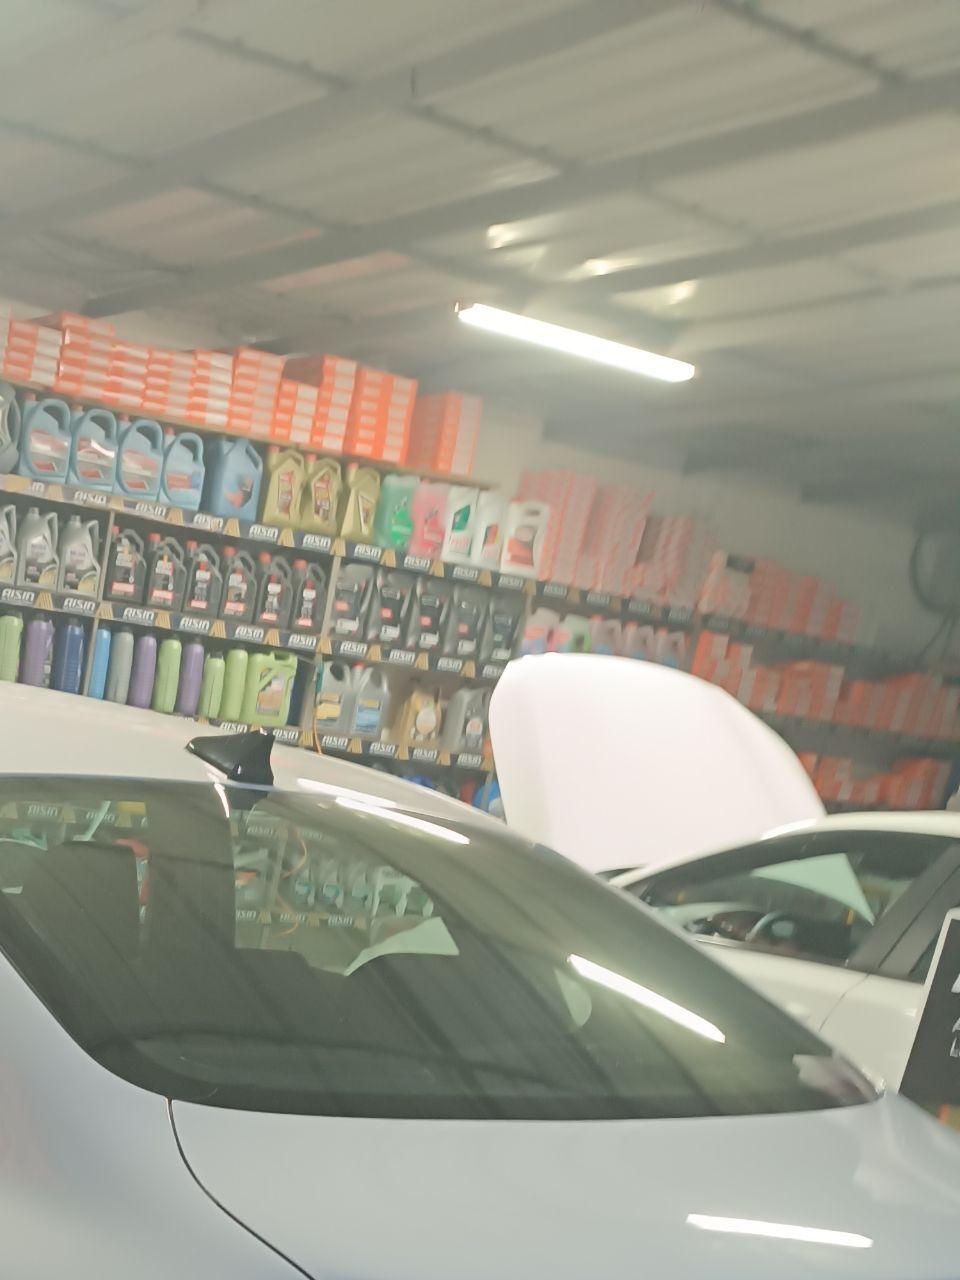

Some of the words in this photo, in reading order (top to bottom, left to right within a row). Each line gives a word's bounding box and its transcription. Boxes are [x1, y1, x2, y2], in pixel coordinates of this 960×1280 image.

[249, 524, 278, 540] AISIN
[303, 534, 331, 548] AISIN
[354, 544, 382, 558] AISIN
[2, 588, 35, 601] AISIN
[64, 597, 96, 611] AISIN
[123, 608, 155, 621] AISIN
[180, 616, 210, 630] AISIN
[236, 625, 264, 639] AISIN
[290, 634, 317, 647] AISIN
